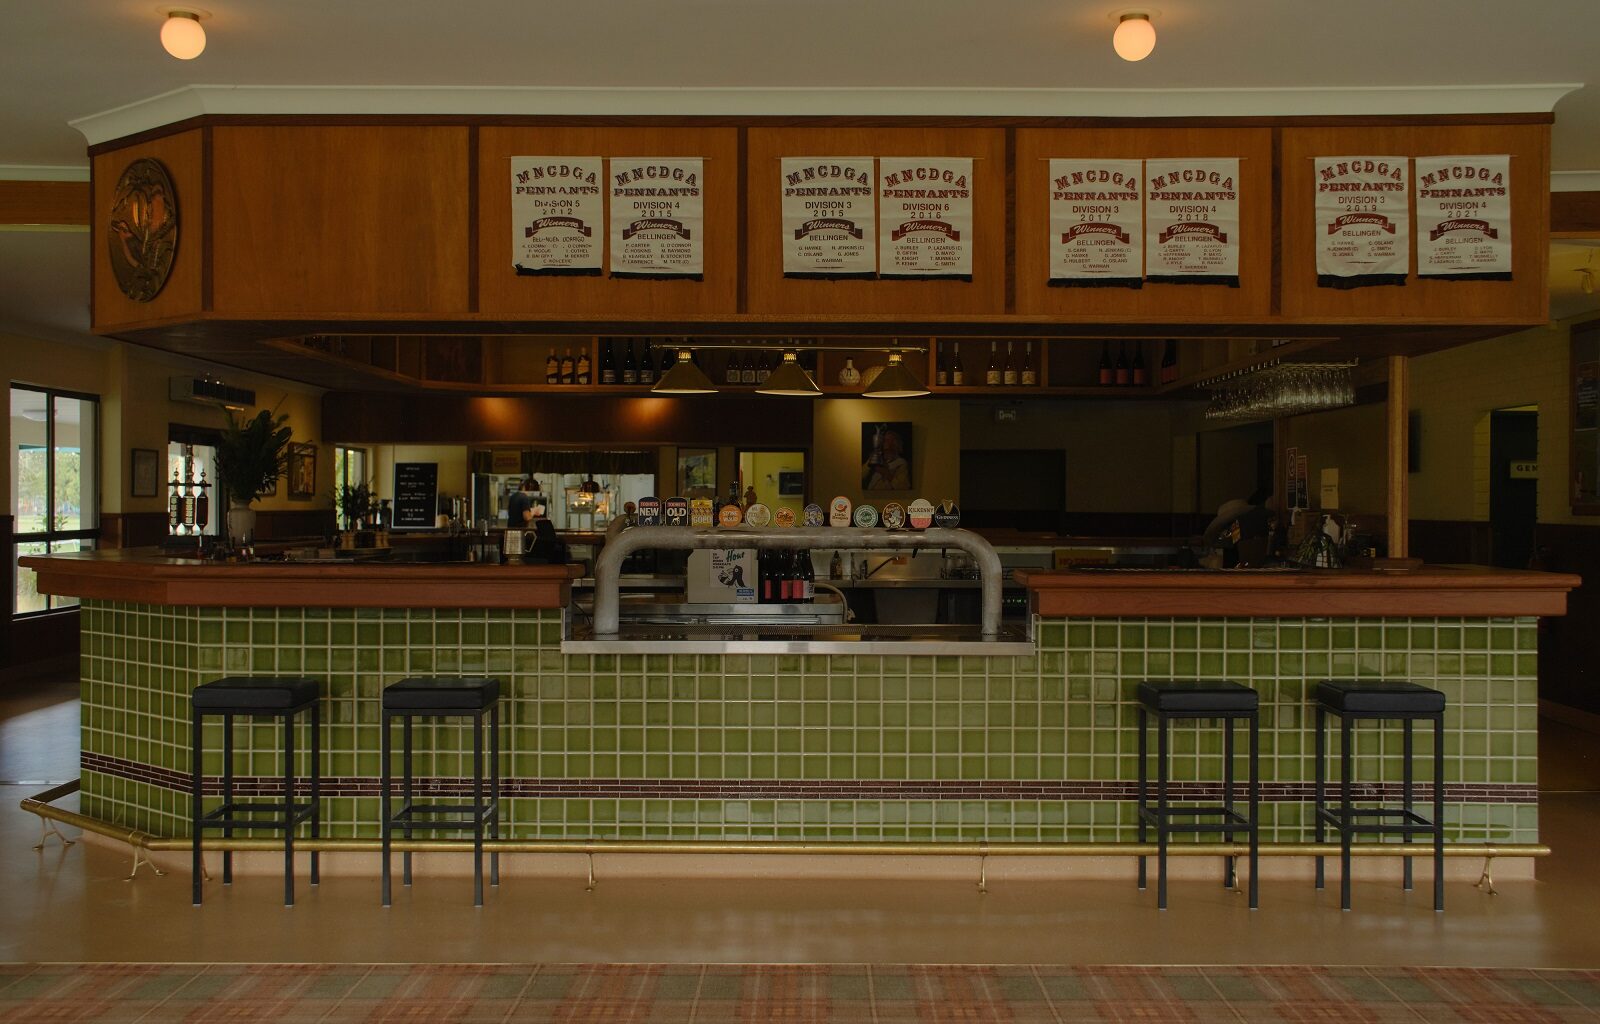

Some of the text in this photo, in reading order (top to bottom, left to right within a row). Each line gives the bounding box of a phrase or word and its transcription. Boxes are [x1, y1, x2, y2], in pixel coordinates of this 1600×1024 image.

[1320, 161, 1401, 181] MNCDGA
[516, 166, 596, 185] MNCDGA
[615, 166, 696, 186] MNCDGA
[786, 166, 868, 186] MNCDGA
[885, 168, 967, 188] MNCDGA
[1421, 167, 1503, 188] MNCDGA
[1054, 170, 1135, 191] MNCDGA
[1151, 170, 1232, 190] MNCDGA
[1319, 183, 1404, 192] PENNANTS
[614, 188, 699, 196] PENNANTS
[785, 188, 871, 196] PENNANTS
[883, 190, 969, 198] PENNANTS
[1054, 192, 1138, 200] PENNANTS
[1150, 192, 1235, 200] PENNANTS
[1420, 188, 1505, 198] PENNANTS
[1440, 202, 1478, 210] DIVISION
[536, 219, 578, 227] Winners
[1340, 216, 1383, 224] Winners
[635, 221, 678, 230] Winners
[806, 221, 850, 229] Winners
[904, 222, 946, 231] Winners
[1074, 225, 1117, 233] Winners
[1171, 225, 1214, 233] Winners
[1441, 222, 1485, 230] Winners
[640, 508, 659, 516] NEW
[667, 508, 686, 516] OLD
